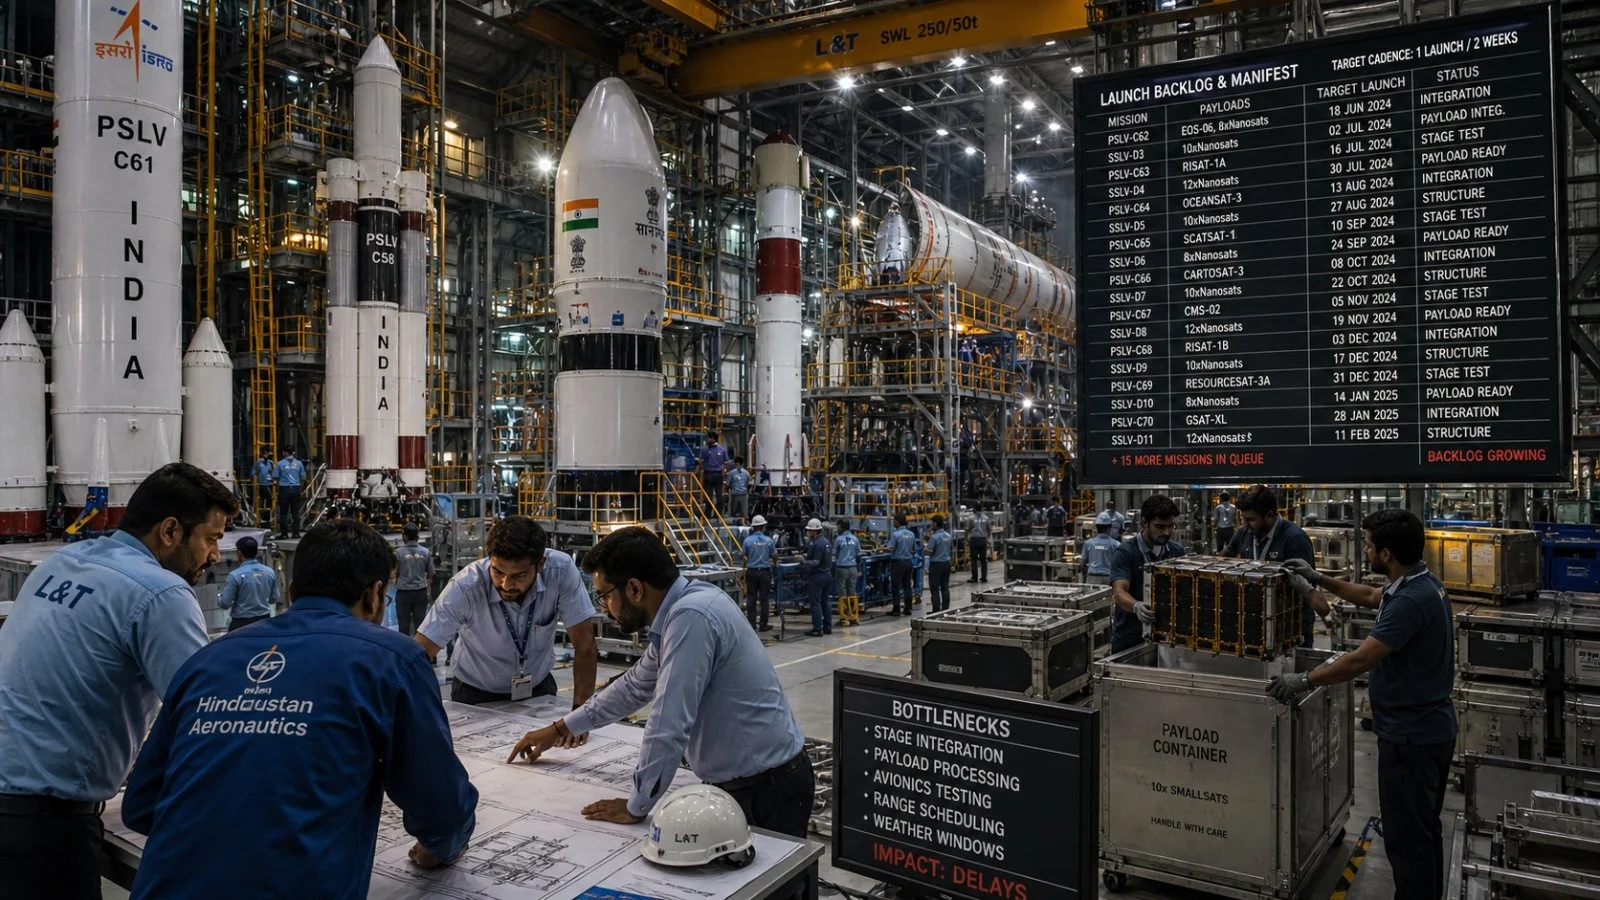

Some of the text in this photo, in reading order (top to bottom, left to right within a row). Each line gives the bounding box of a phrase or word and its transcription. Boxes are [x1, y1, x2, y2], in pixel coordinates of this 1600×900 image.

[816, 15, 978, 56] L&T SWL 250/50t
[1332, 31, 1517, 70] TARGET CADENCE: 1 LAUNCH / 2 WEEKS
[1437, 66, 1479, 81] STATUS
[1101, 64, 1298, 106] LAUNCH BACKLOG & MANIFEST
[1317, 76, 1405, 97] TARGET LAUNCH
[1421, 85, 1490, 104] INTEGRATION
[1200, 98, 1250, 114] PAYLOADS
[1329, 99, 1391, 116] 18 JUN 2024
[1108, 113, 1147, 127] MISSION
[1421, 104, 1505, 124] PAYLOAD INTEG.
[98, 115, 167, 147] PSLV
[1181, 116, 1268, 135] EOS-06, 8xNanosats
[1108, 131, 1148, 145] PSLV-C62
[1421, 126, 1484, 144] STAGE TEST
[1330, 138, 1391, 154] 16 JUL 2024
[1108, 149, 1144, 162] SSLV-D3
[1422, 145, 1506, 163] PAYLOAD READY
[114, 150, 153, 174] C61
[1182, 157, 1225, 171] RISAT-1A
[1108, 166, 1149, 180] PSLV-C63
[1422, 166, 1493, 183] INTEGRATION
[1183, 176, 1238, 189] 12xNanosats
[1331, 177, 1393, 192] 13 AUG 2024
[1109, 185, 1144, 197] SSLV-D4
[1422, 187, 1485, 203] STRUCTURE
[1183, 192, 1241, 208] OCEANSAT-3
[1109, 202, 1150, 215] PSLV-C64
[1423, 207, 1486, 222] STAGE TEST
[1183, 212, 1238, 225] 10xNanosats
[1331, 215, 1394, 230] 10 SEP 2024
[1109, 220, 1145, 233] SSLV-D5
[1423, 225, 1508, 242] PAYLOAD READY
[366, 233, 398, 249] PSLV
[1184, 229, 1234, 243] SCATSAT-1
[1109, 237, 1150, 250] PSLV-C65
[372, 251, 394, 265] C58
[1183, 249, 1237, 262] 8xNanosats
[1424, 246, 1495, 261] INTEGRATION
[1109, 255, 1145, 268] SSLV-D6
[1331, 254, 1395, 268] 08 OCT 2024
[1110, 273, 1151, 285] PSLV-C66
[1184, 266, 1243, 279] CARTOSAT-3
[1424, 266, 1486, 281] STRUCTURE
[123, 201, 145, 380] INDIA
[1110, 291, 1145, 303] SSLV-D7
[1184, 285, 1241, 297] 10xNanosats
[1424, 286, 1488, 300] STAGE TEST
[1332, 292, 1396, 306] 05 NOV 2024
[1110, 308, 1151, 320] PSLV-C67
[1184, 304, 1220, 316] CMS-02
[1425, 305, 1511, 320] PAYLOAD READY
[1110, 327, 1146, 338] SSLV-D8
[1185, 322, 1242, 333] 12xNanosats
[1425, 326, 1497, 339] INTEGRATION
[1332, 331, 1396, 344] 03 DEC 2024
[1110, 344, 1152, 356] PSLV-C68
[1185, 340, 1228, 351] RISAT-1B
[1425, 346, 1489, 359] STRUCTURE
[377, 316, 389, 410] INDIA
[1111, 362, 1147, 374] SSLV-D9
[1186, 359, 1243, 370] 10xNanosats
[1333, 370, 1397, 383] 31 DEC 2024
[1426, 366, 1490, 379] STAGE TEST
[1111, 380, 1152, 391] PSLV-C69
[1186, 376, 1270, 388] RESOURCESAT-3A
[1426, 385, 1513, 398] PAYLOAD READY
[1111, 398, 1153, 409] SSLV-D10
[1186, 396, 1239, 406] 8xNanosats
[1334, 409, 1398, 421] 28 JAN 2025
[1427, 406, 1499, 418] INTEGRATION
[1111, 416, 1153, 427] PSLV-C70
[1186, 414, 1227, 425] GSAT-XL
[1427, 426, 1490, 438] STRUCTURE
[1112, 434, 1152, 445] SSLV-D11
[1121, 455, 1131, 465] 15
[1135, 455, 1161, 465] MORE
[1165, 454, 1212, 464] MISSIONS
[1216, 454, 1225, 464] IN
[1230, 453, 1263, 465] QUEUE
[1428, 449, 1545, 461] BACKLOG GROWING
[34, 574, 95, 609] L&T
[892, 700, 1010, 738] BOTTLENECKS
[188, 717, 308, 736] Aeronautics
[1162, 723, 1219, 744] PAYLOAD
[874, 725, 1003, 765] STAGE INTEGRATION
[1153, 740, 1227, 764] CONTAINER
[874, 747, 1020, 792] PAYLOAD PROCESSING
[873, 769, 991, 809] AVIONICS TESTING
[1151, 782, 1228, 805] 10x SMALLSATS
[874, 791, 1005, 837] RANGE SCHEDULING
[1151, 817, 1228, 839] HANDLE WITH CARE
[873, 813, 1004, 861] WEATHER WINDOWS
[873, 843, 1027, 900] IMPACT: DELAYS
